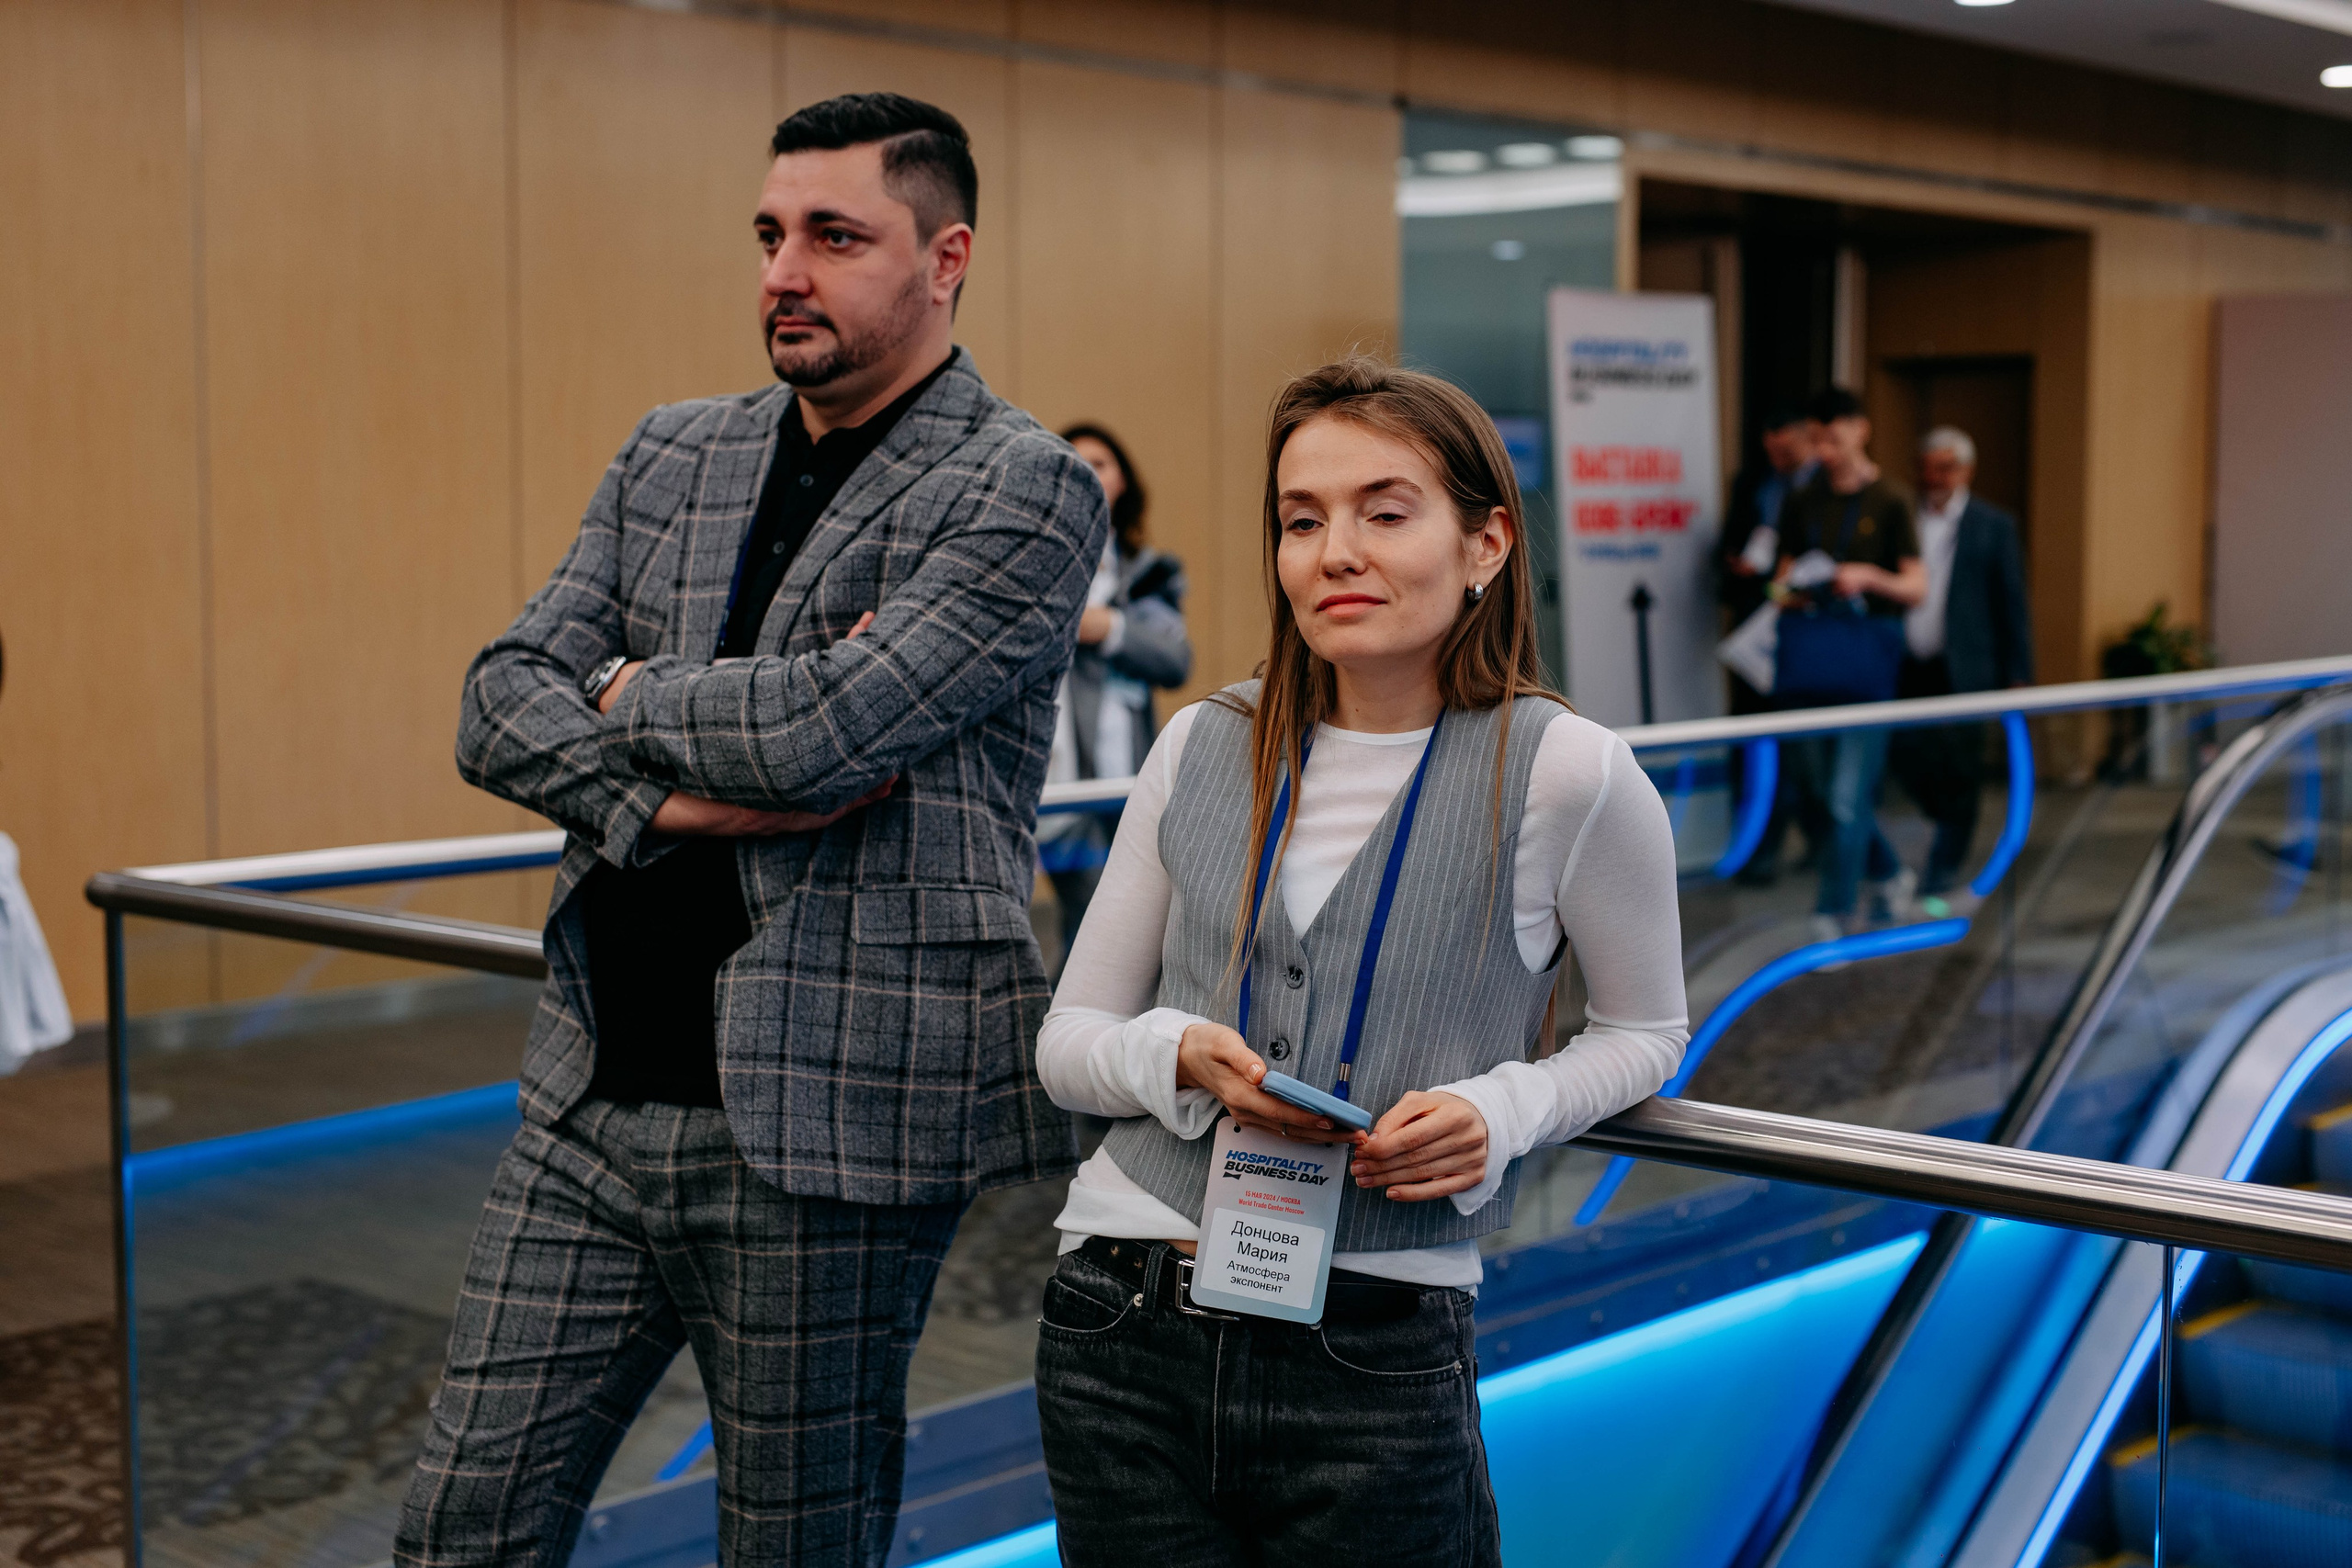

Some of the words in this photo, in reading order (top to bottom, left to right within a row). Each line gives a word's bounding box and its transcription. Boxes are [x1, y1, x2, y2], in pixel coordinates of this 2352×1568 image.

[1226, 1150, 1324, 1173] HOSPITALITY
[1225, 1161, 1296, 1180] BUSINESS
[1298, 1173, 1329, 1186] DAY
[1263, 1193, 1276, 1201] 2024
[1280, 1196, 1301, 1205] МОСКВА
[1268, 1203, 1284, 1212] Center
[1231, 1221, 1300, 1246] Донцова
[1237, 1241, 1288, 1263] Мария
[1227, 1260, 1291, 1282] Атмосфера
